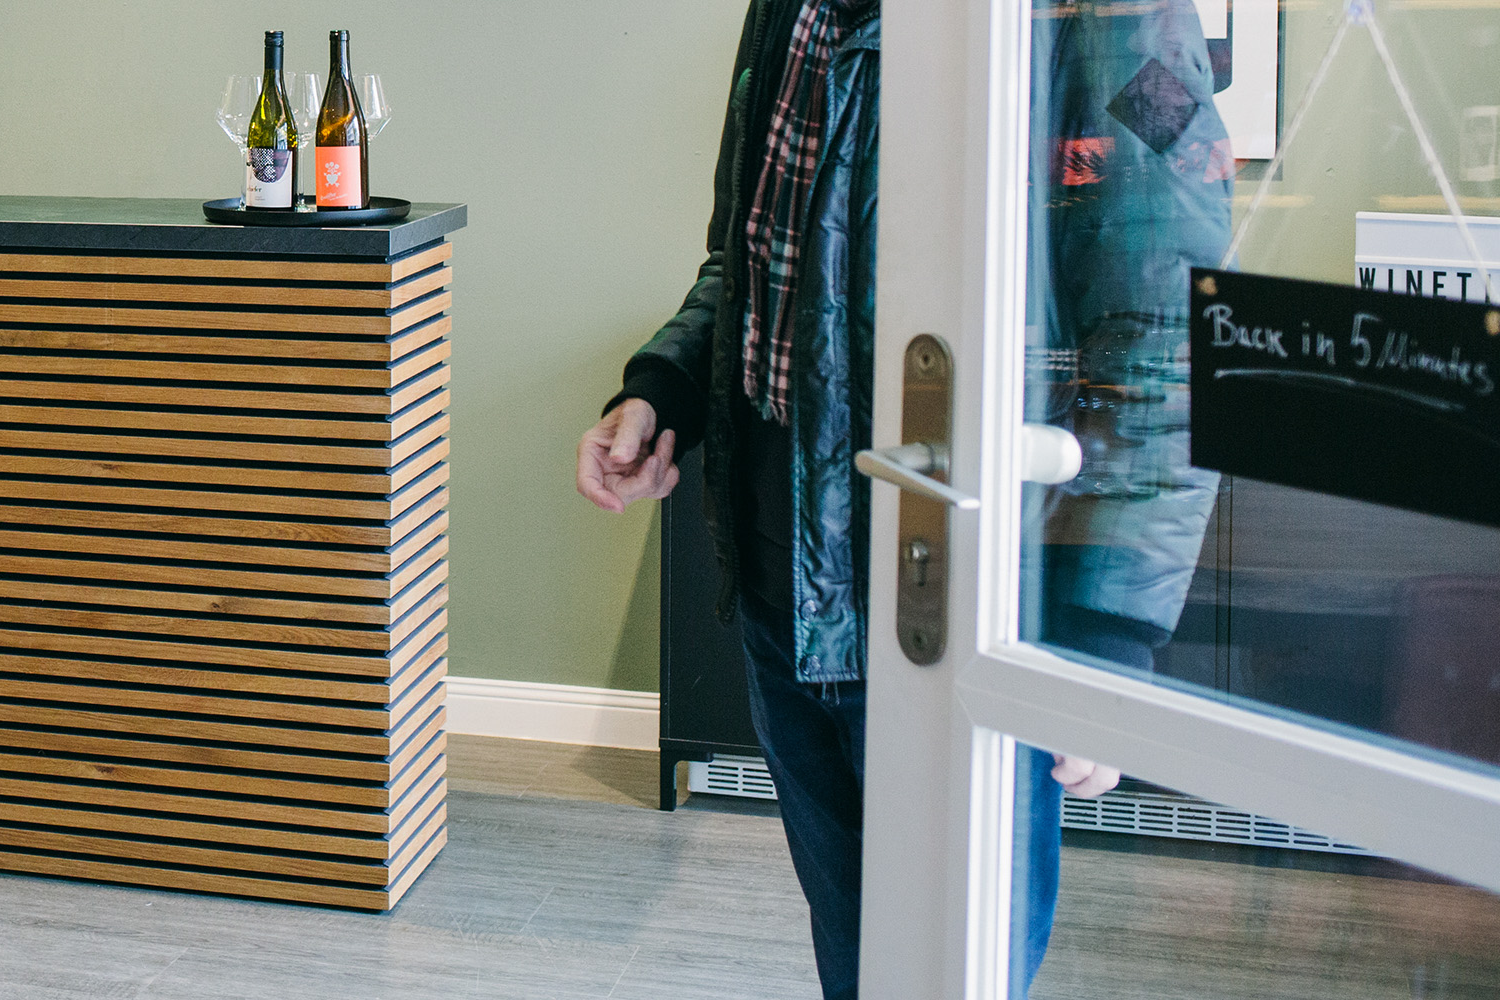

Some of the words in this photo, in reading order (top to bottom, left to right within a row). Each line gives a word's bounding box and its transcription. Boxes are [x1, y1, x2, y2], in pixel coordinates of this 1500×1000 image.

[1202, 303, 1289, 359] Back
[1301, 320, 1336, 366] in
[1350, 311, 1382, 368] 5
[1376, 330, 1495, 396] Minutes
